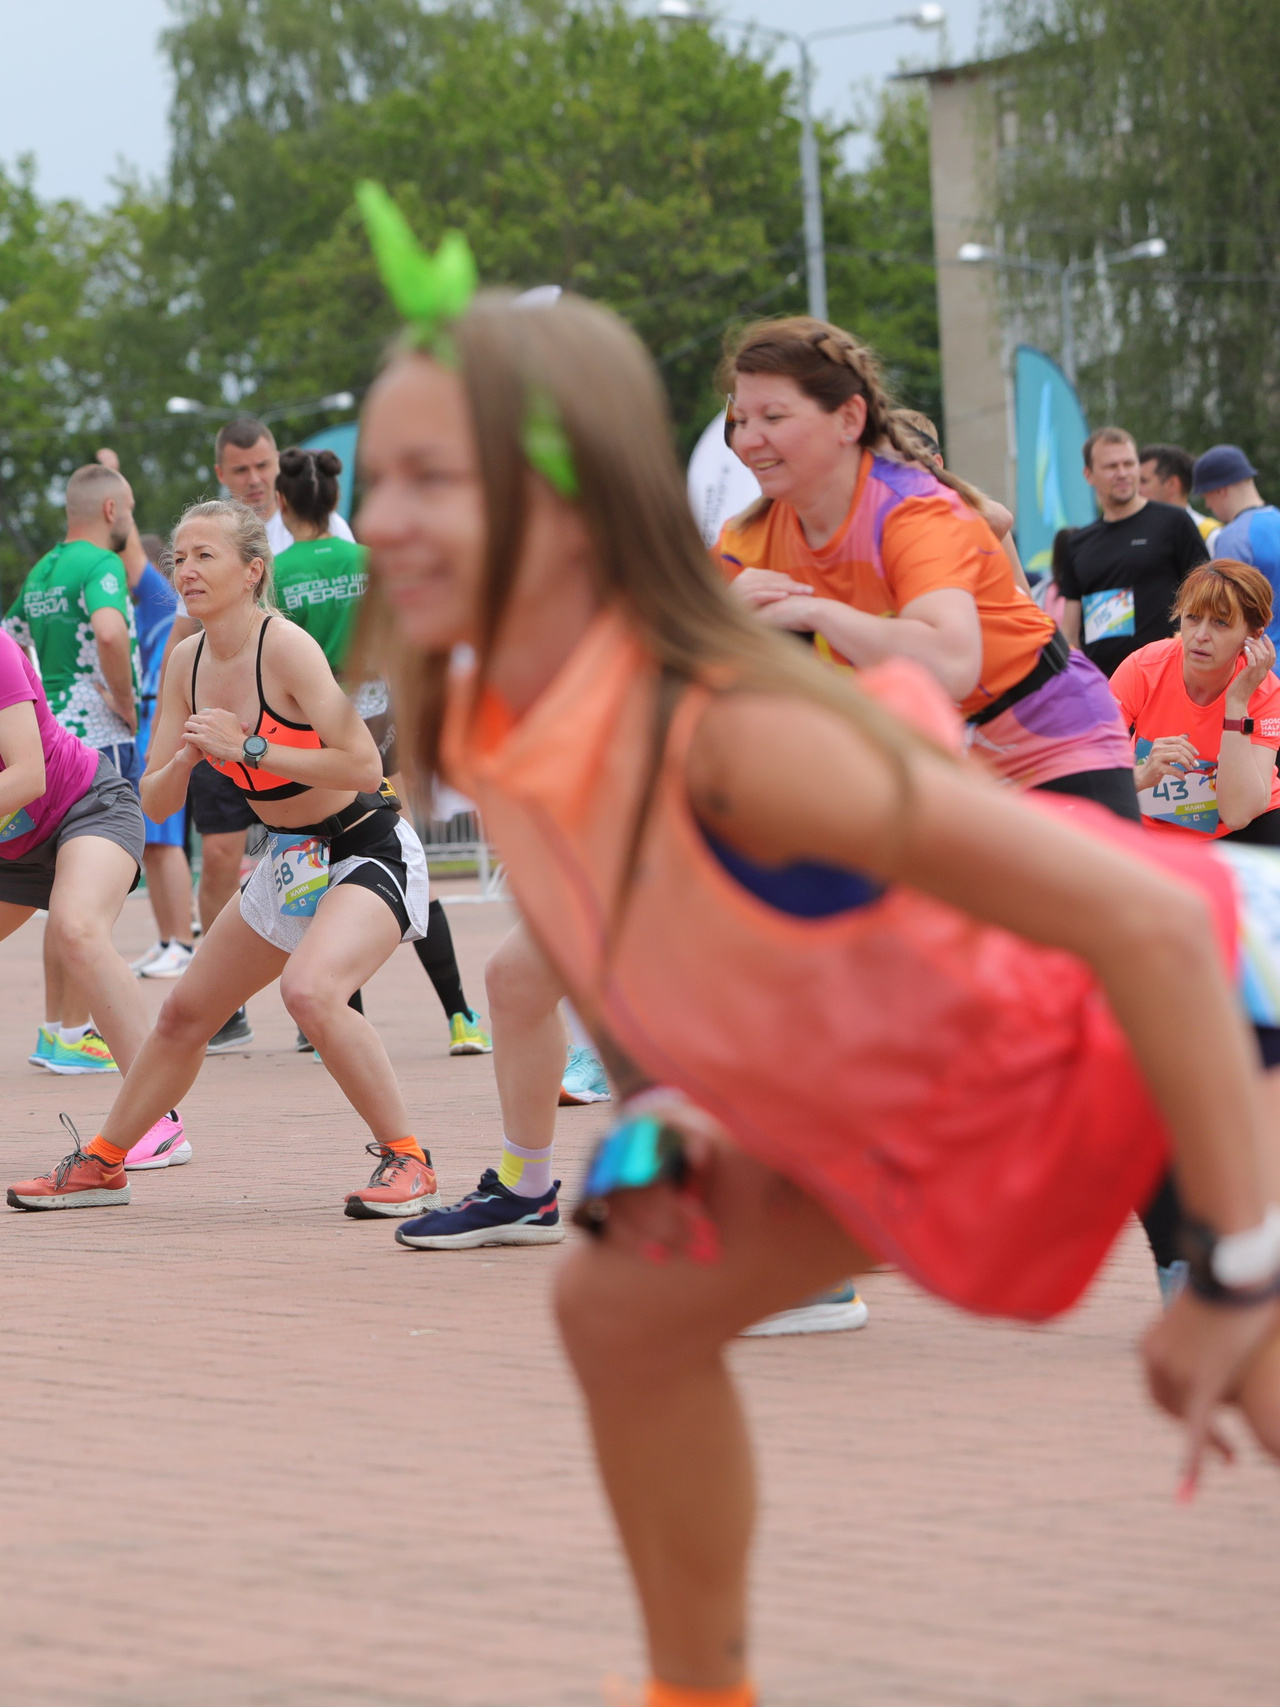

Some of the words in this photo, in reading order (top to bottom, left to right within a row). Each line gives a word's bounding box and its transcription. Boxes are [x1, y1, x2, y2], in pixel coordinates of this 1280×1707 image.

[1152, 780, 1189, 801] 43
[1184, 803, 1206, 812] КЛИН
[289, 884, 310, 898] КЛИН
